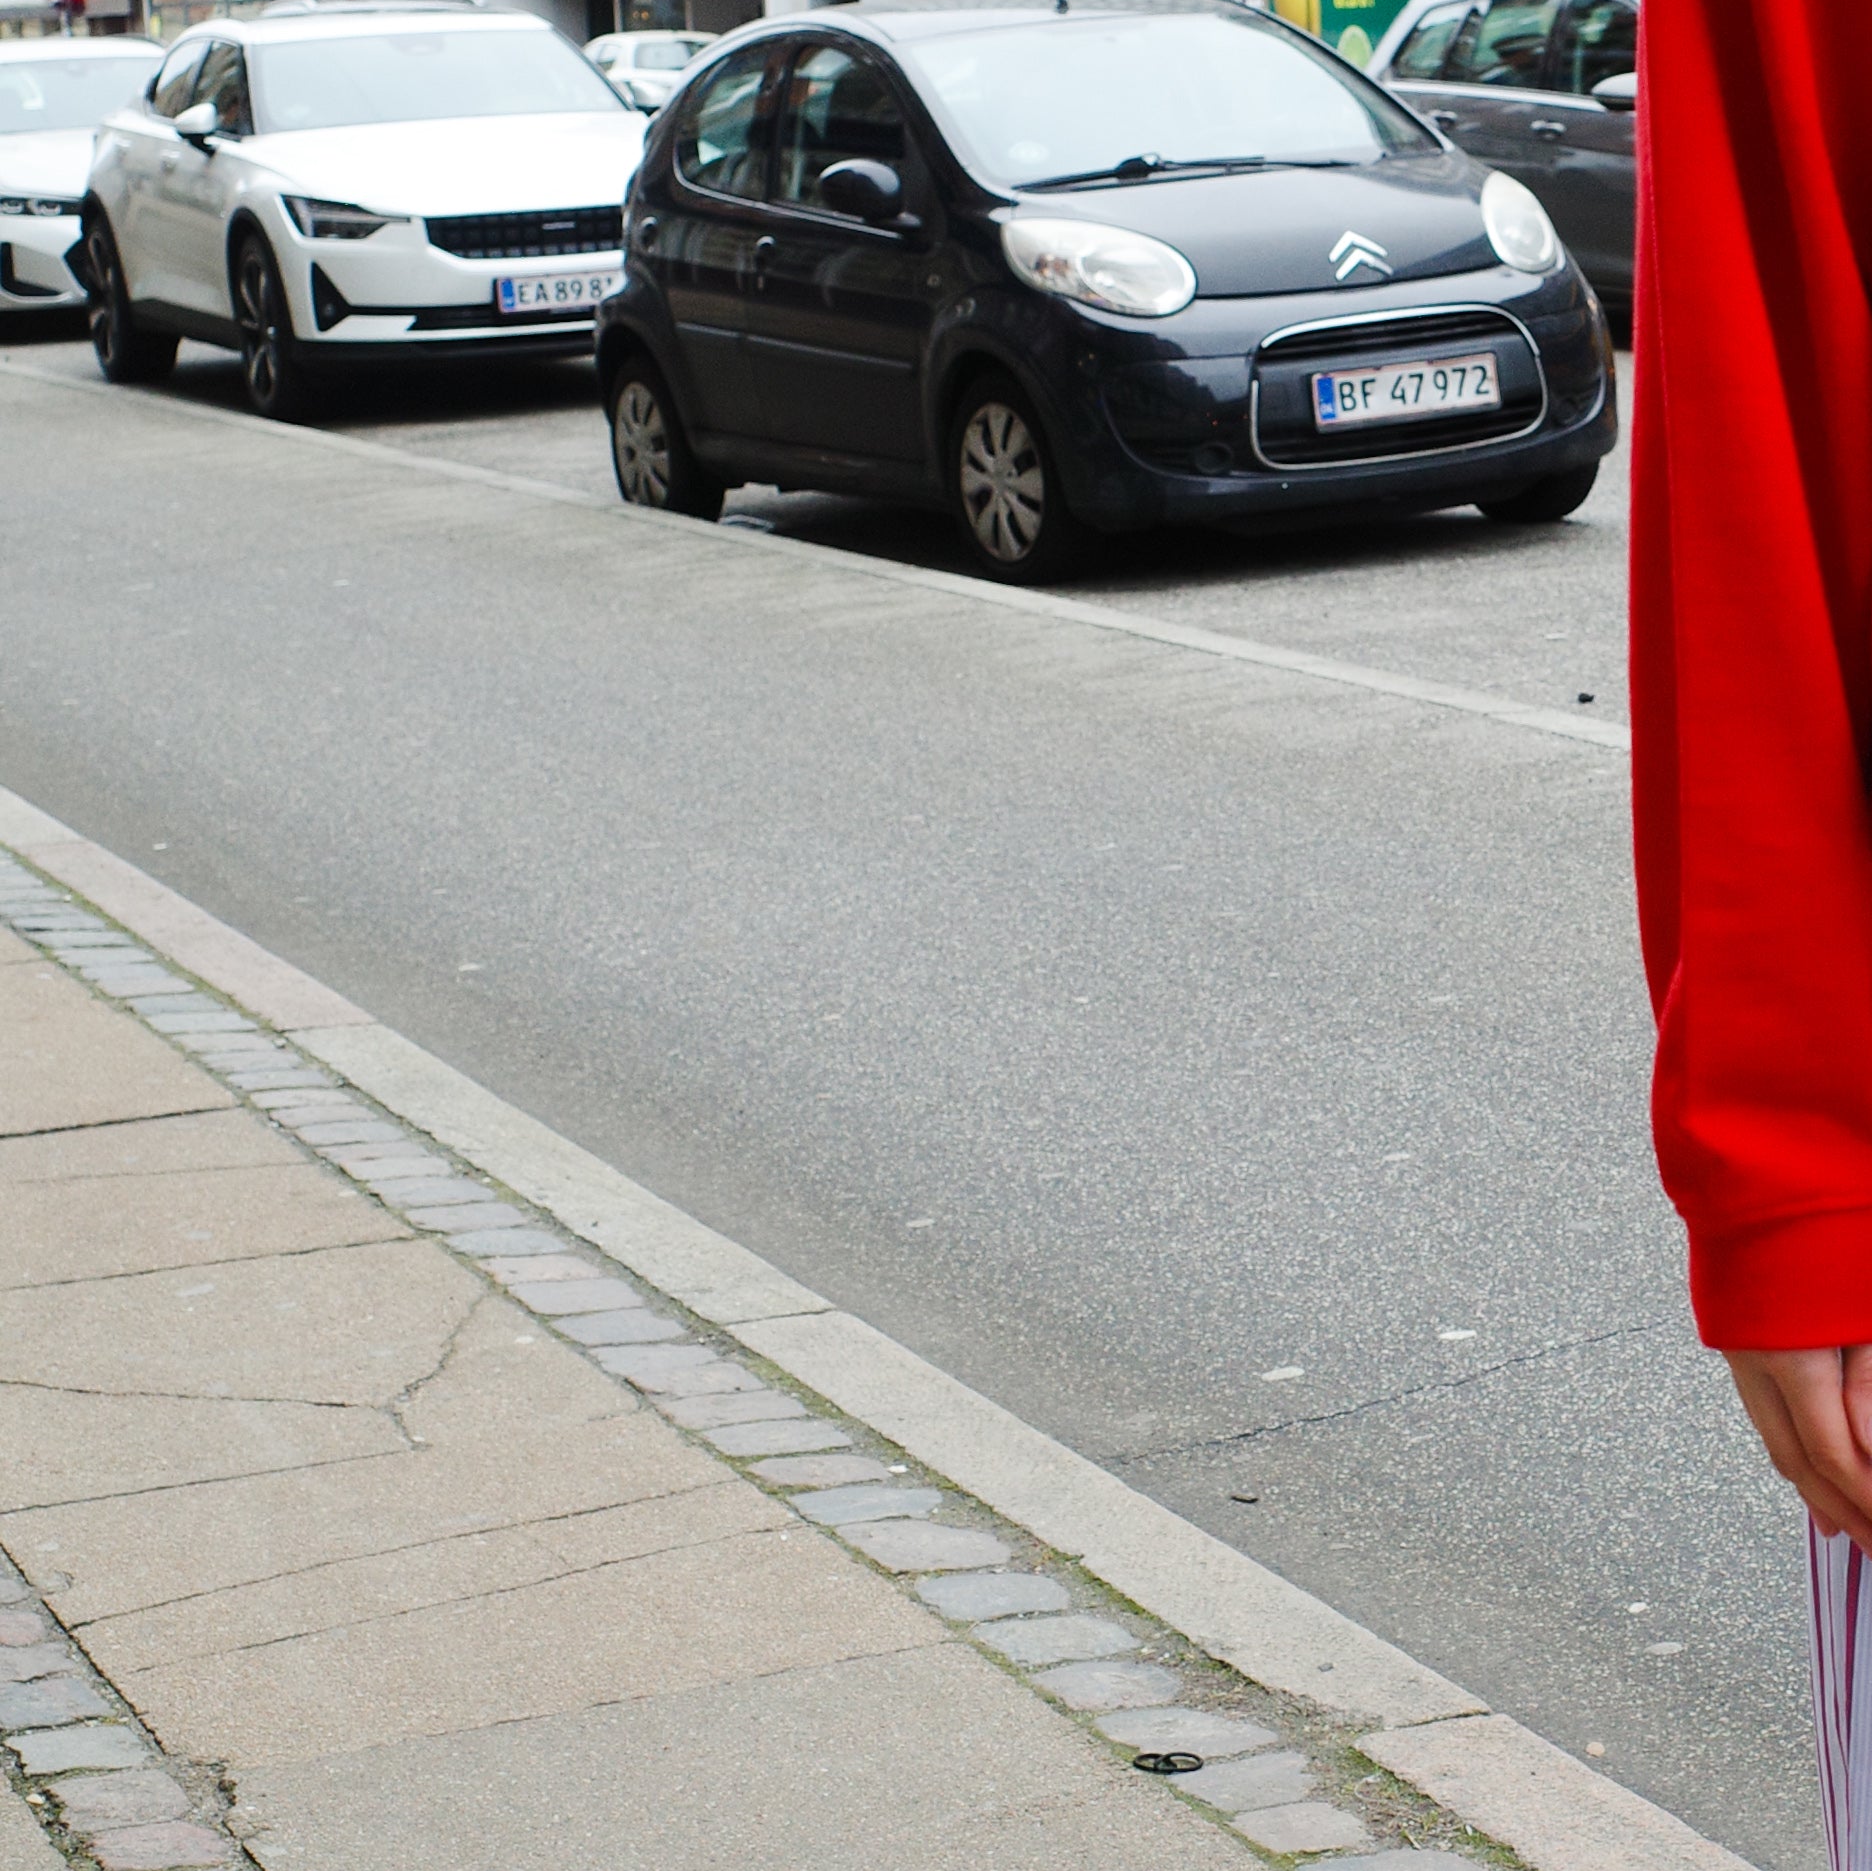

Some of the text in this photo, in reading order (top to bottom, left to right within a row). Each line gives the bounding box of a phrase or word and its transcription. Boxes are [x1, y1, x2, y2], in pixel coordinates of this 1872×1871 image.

[518, 283, 549, 303] EA
[555, 279, 583, 301] 89
[1338, 378, 1376, 412] BF
